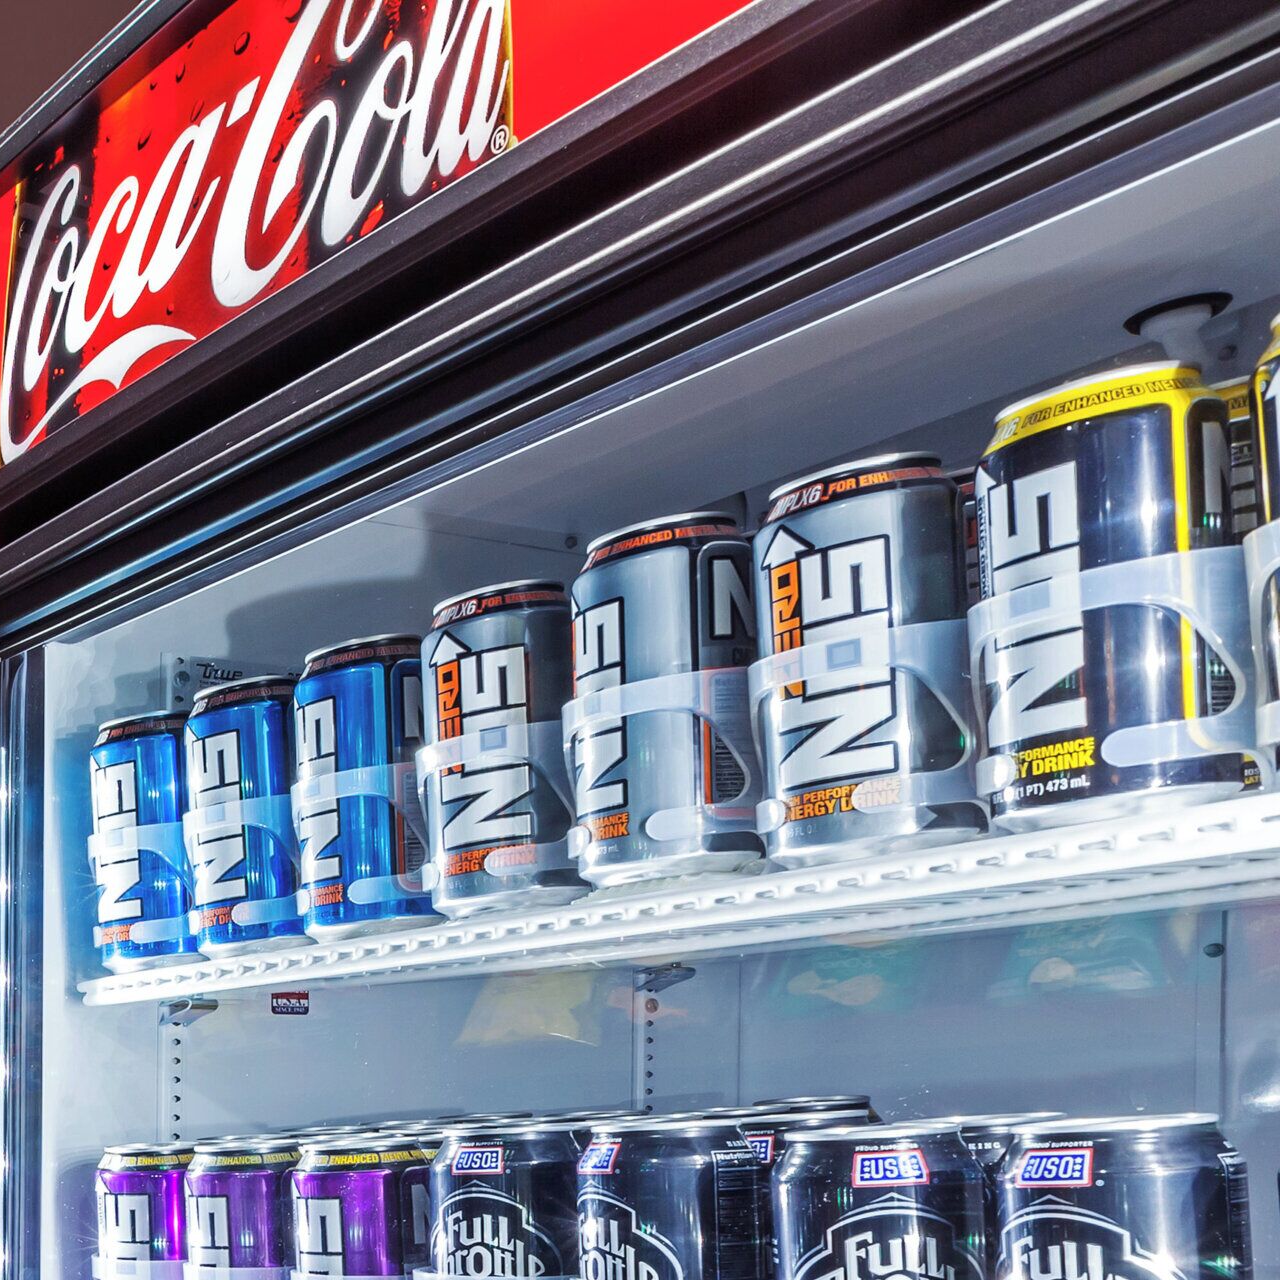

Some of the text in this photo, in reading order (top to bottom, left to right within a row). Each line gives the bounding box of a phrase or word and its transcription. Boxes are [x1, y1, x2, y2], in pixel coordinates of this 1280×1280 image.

[0, 0, 509, 462] Coca-Cola
[1021, 384, 1145, 430] FOR ENHANCED
[828, 476, 858, 494] FOR
[610, 529, 673, 553] ENHANCED
[481, 596, 502, 610] FOR
[986, 461, 1088, 749] NOS
[196, 662, 243, 681] True
[780, 536, 898, 788] NOS
[575, 599, 627, 817] NOS
[442, 644, 534, 851] NOS
[1030, 752, 1095, 778] DRINK
[297, 698, 341, 883] NOS
[1045, 778, 1069, 793] 473
[1069, 774, 1090, 789] mL
[840, 788, 901, 812] DRINK
[193, 730, 247, 906] NOS
[95, 760, 143, 924] NOS
[443, 860, 485, 878] ENERGY
[1052, 1140, 1093, 1149] SUPPORTER
[218, 1153, 262, 1165] ENHANCED
[330, 1151, 379, 1165] ENHANCED
[463, 1152, 492, 1170] USO
[1032, 1155, 1074, 1180] USO
